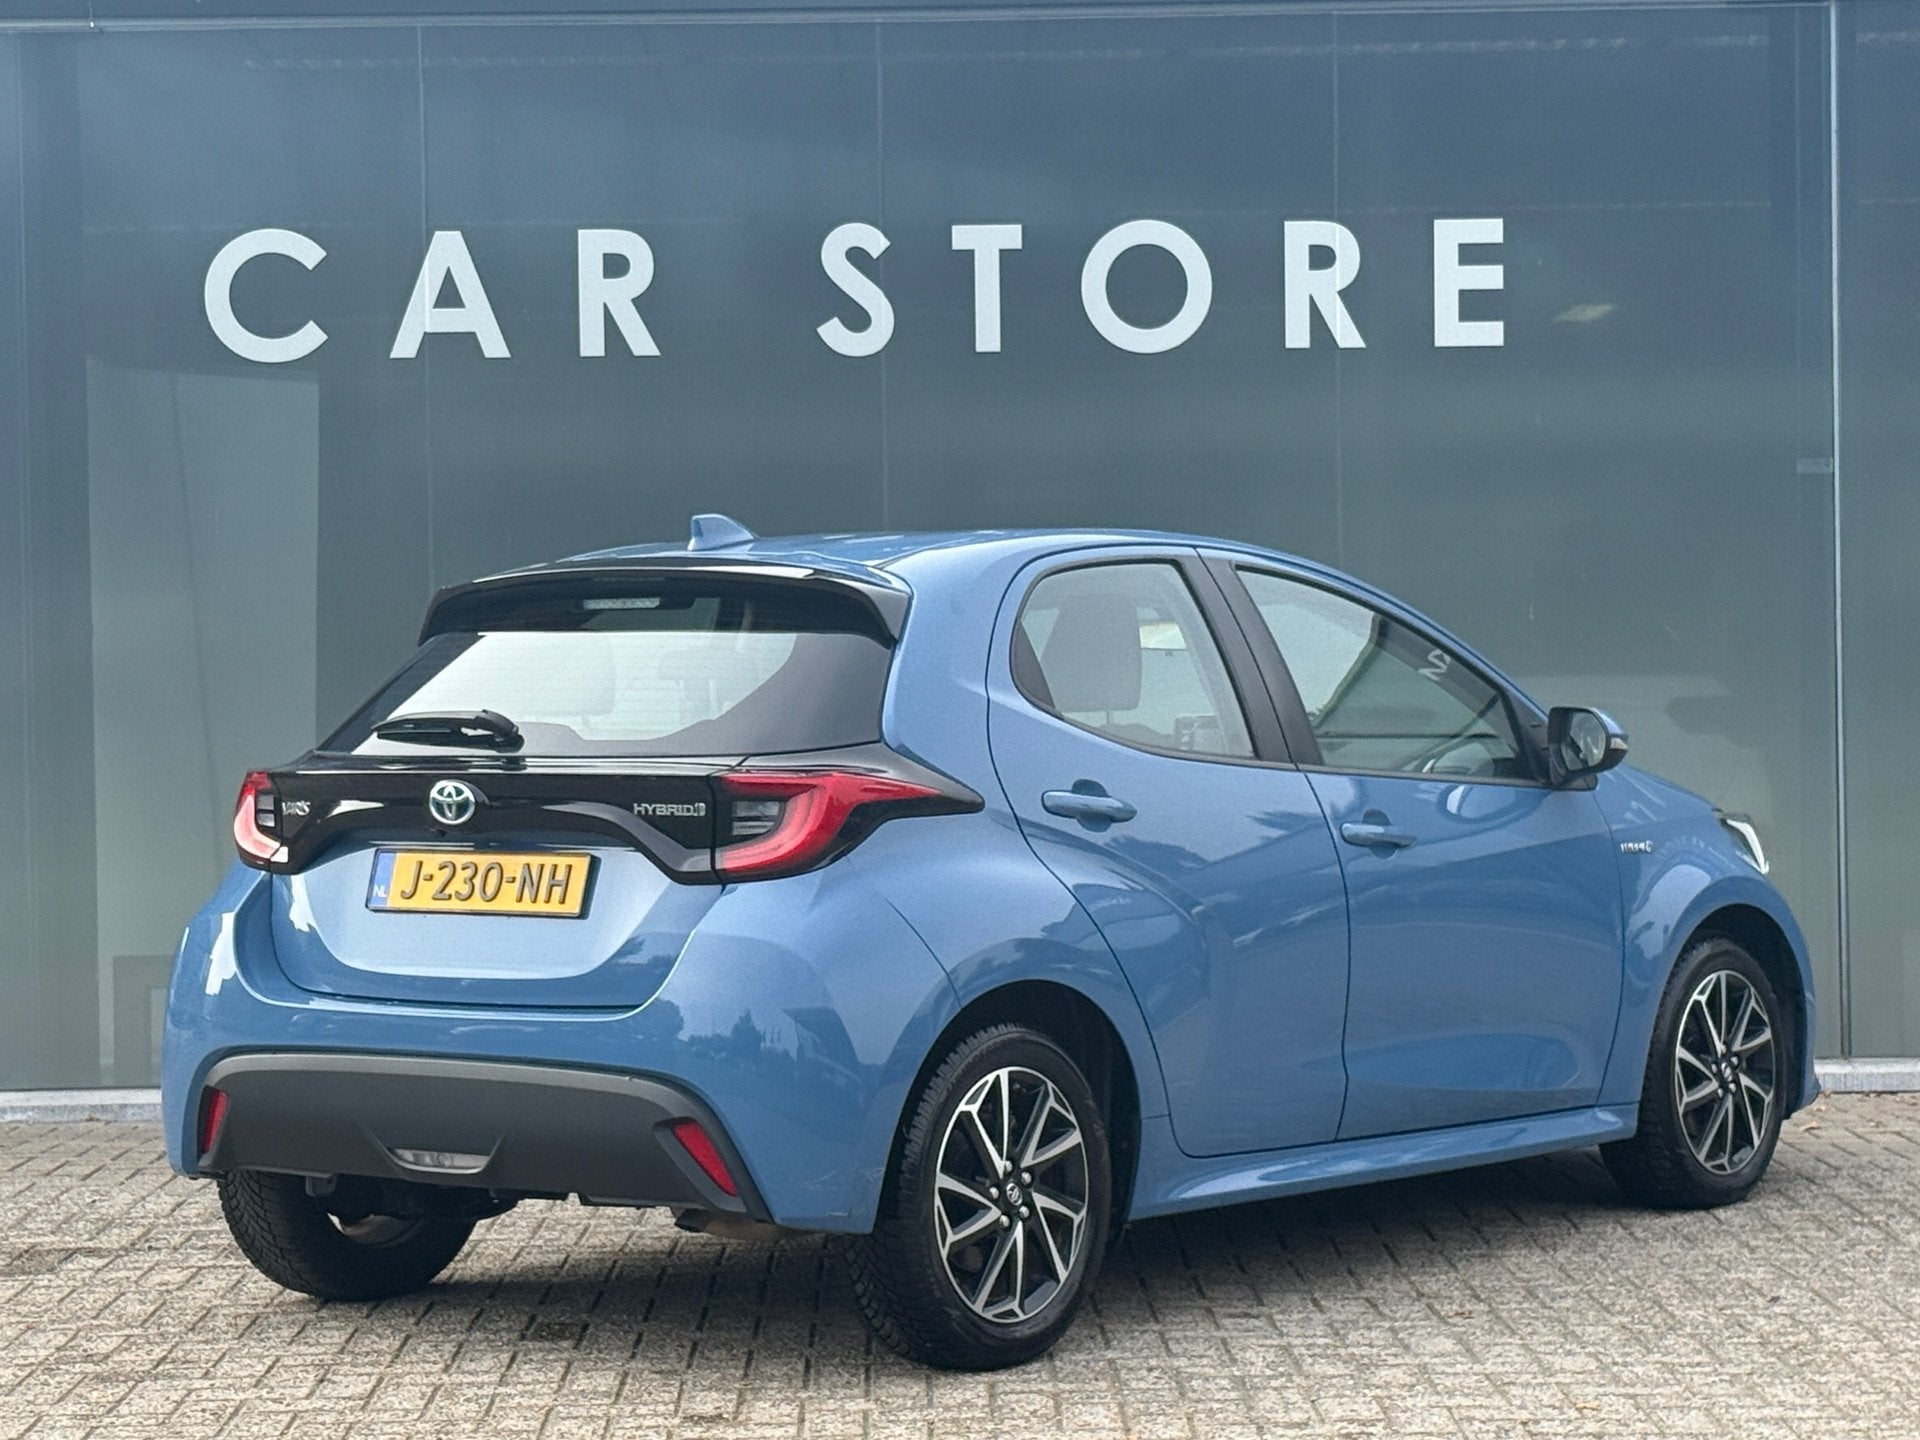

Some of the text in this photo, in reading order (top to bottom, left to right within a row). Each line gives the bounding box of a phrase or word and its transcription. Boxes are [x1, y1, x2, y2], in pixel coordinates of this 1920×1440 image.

[204, 218, 1505, 364] CAR STORE
[633, 803, 694, 817] HYBRID
[373, 884, 388, 898] NL
[400, 860, 573, 905] J-230-NH
